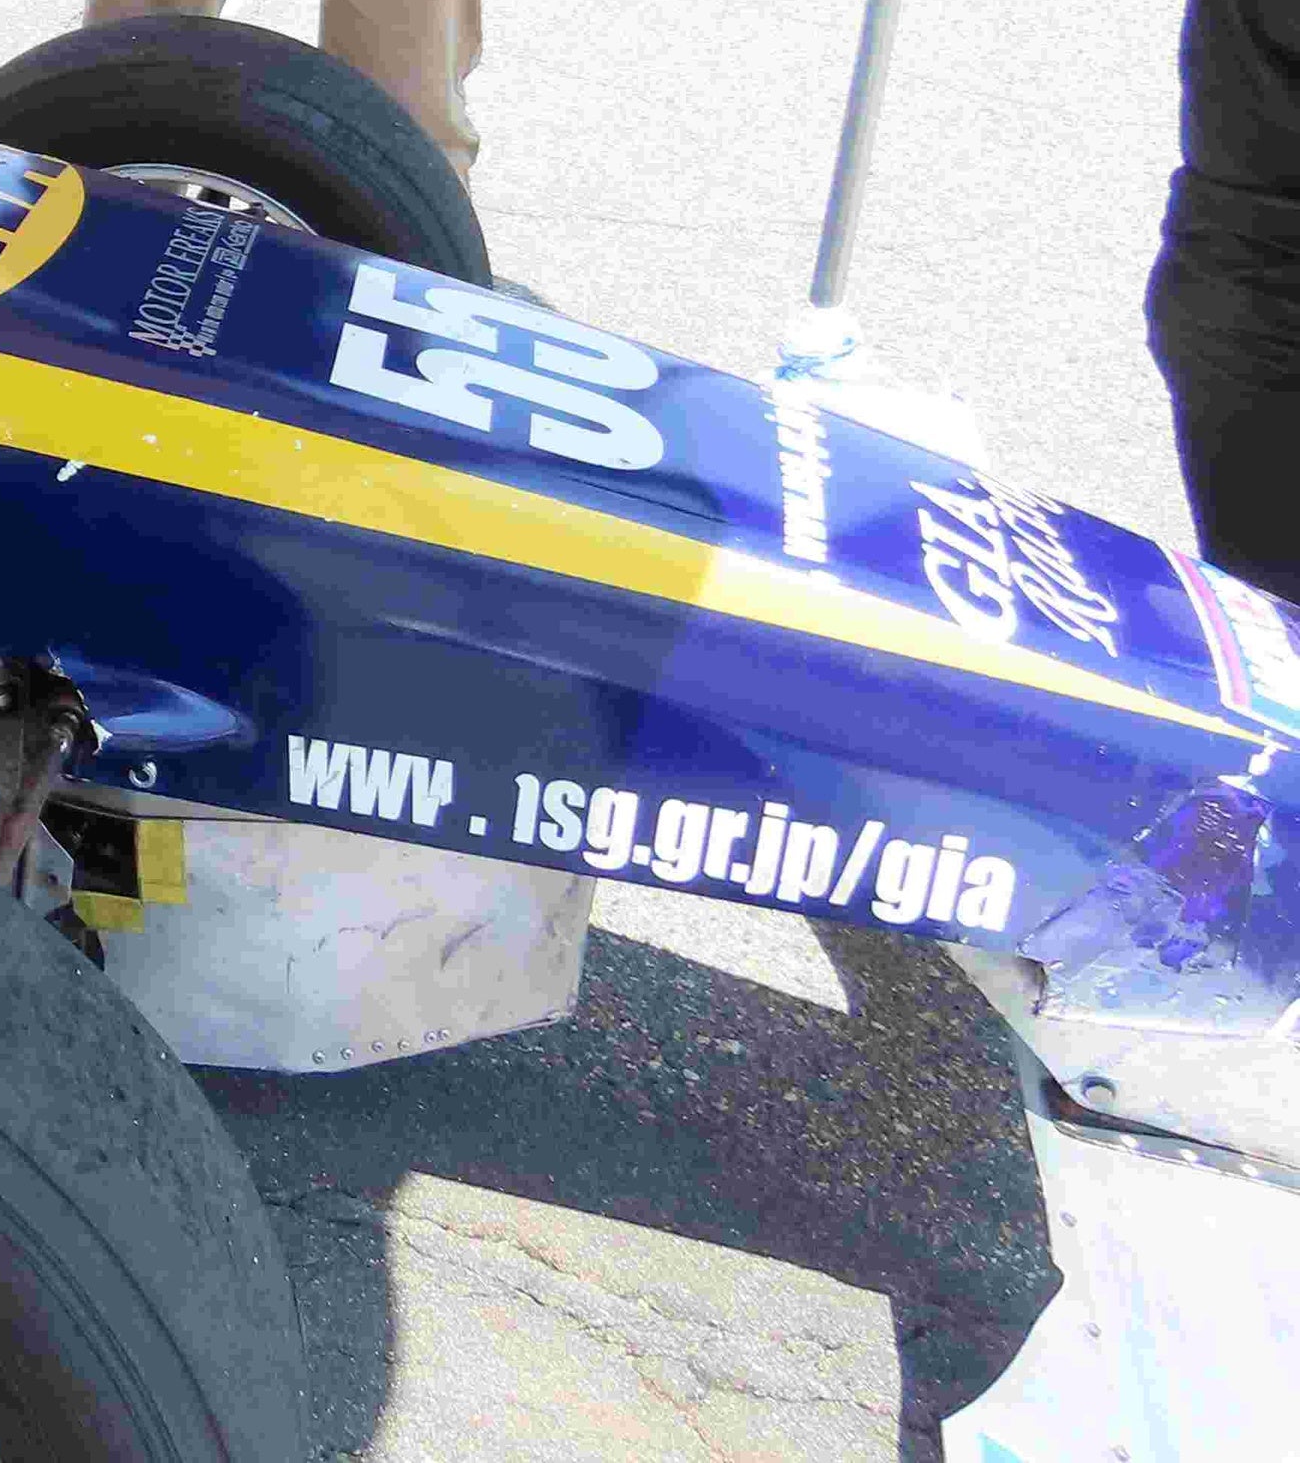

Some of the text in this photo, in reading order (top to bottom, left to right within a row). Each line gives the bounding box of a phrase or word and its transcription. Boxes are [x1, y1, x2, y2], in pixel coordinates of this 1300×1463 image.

[128, 263, 196, 351] MOTOR
[164, 206, 225, 264] FREAKS
[329, 263, 665, 470] 55
